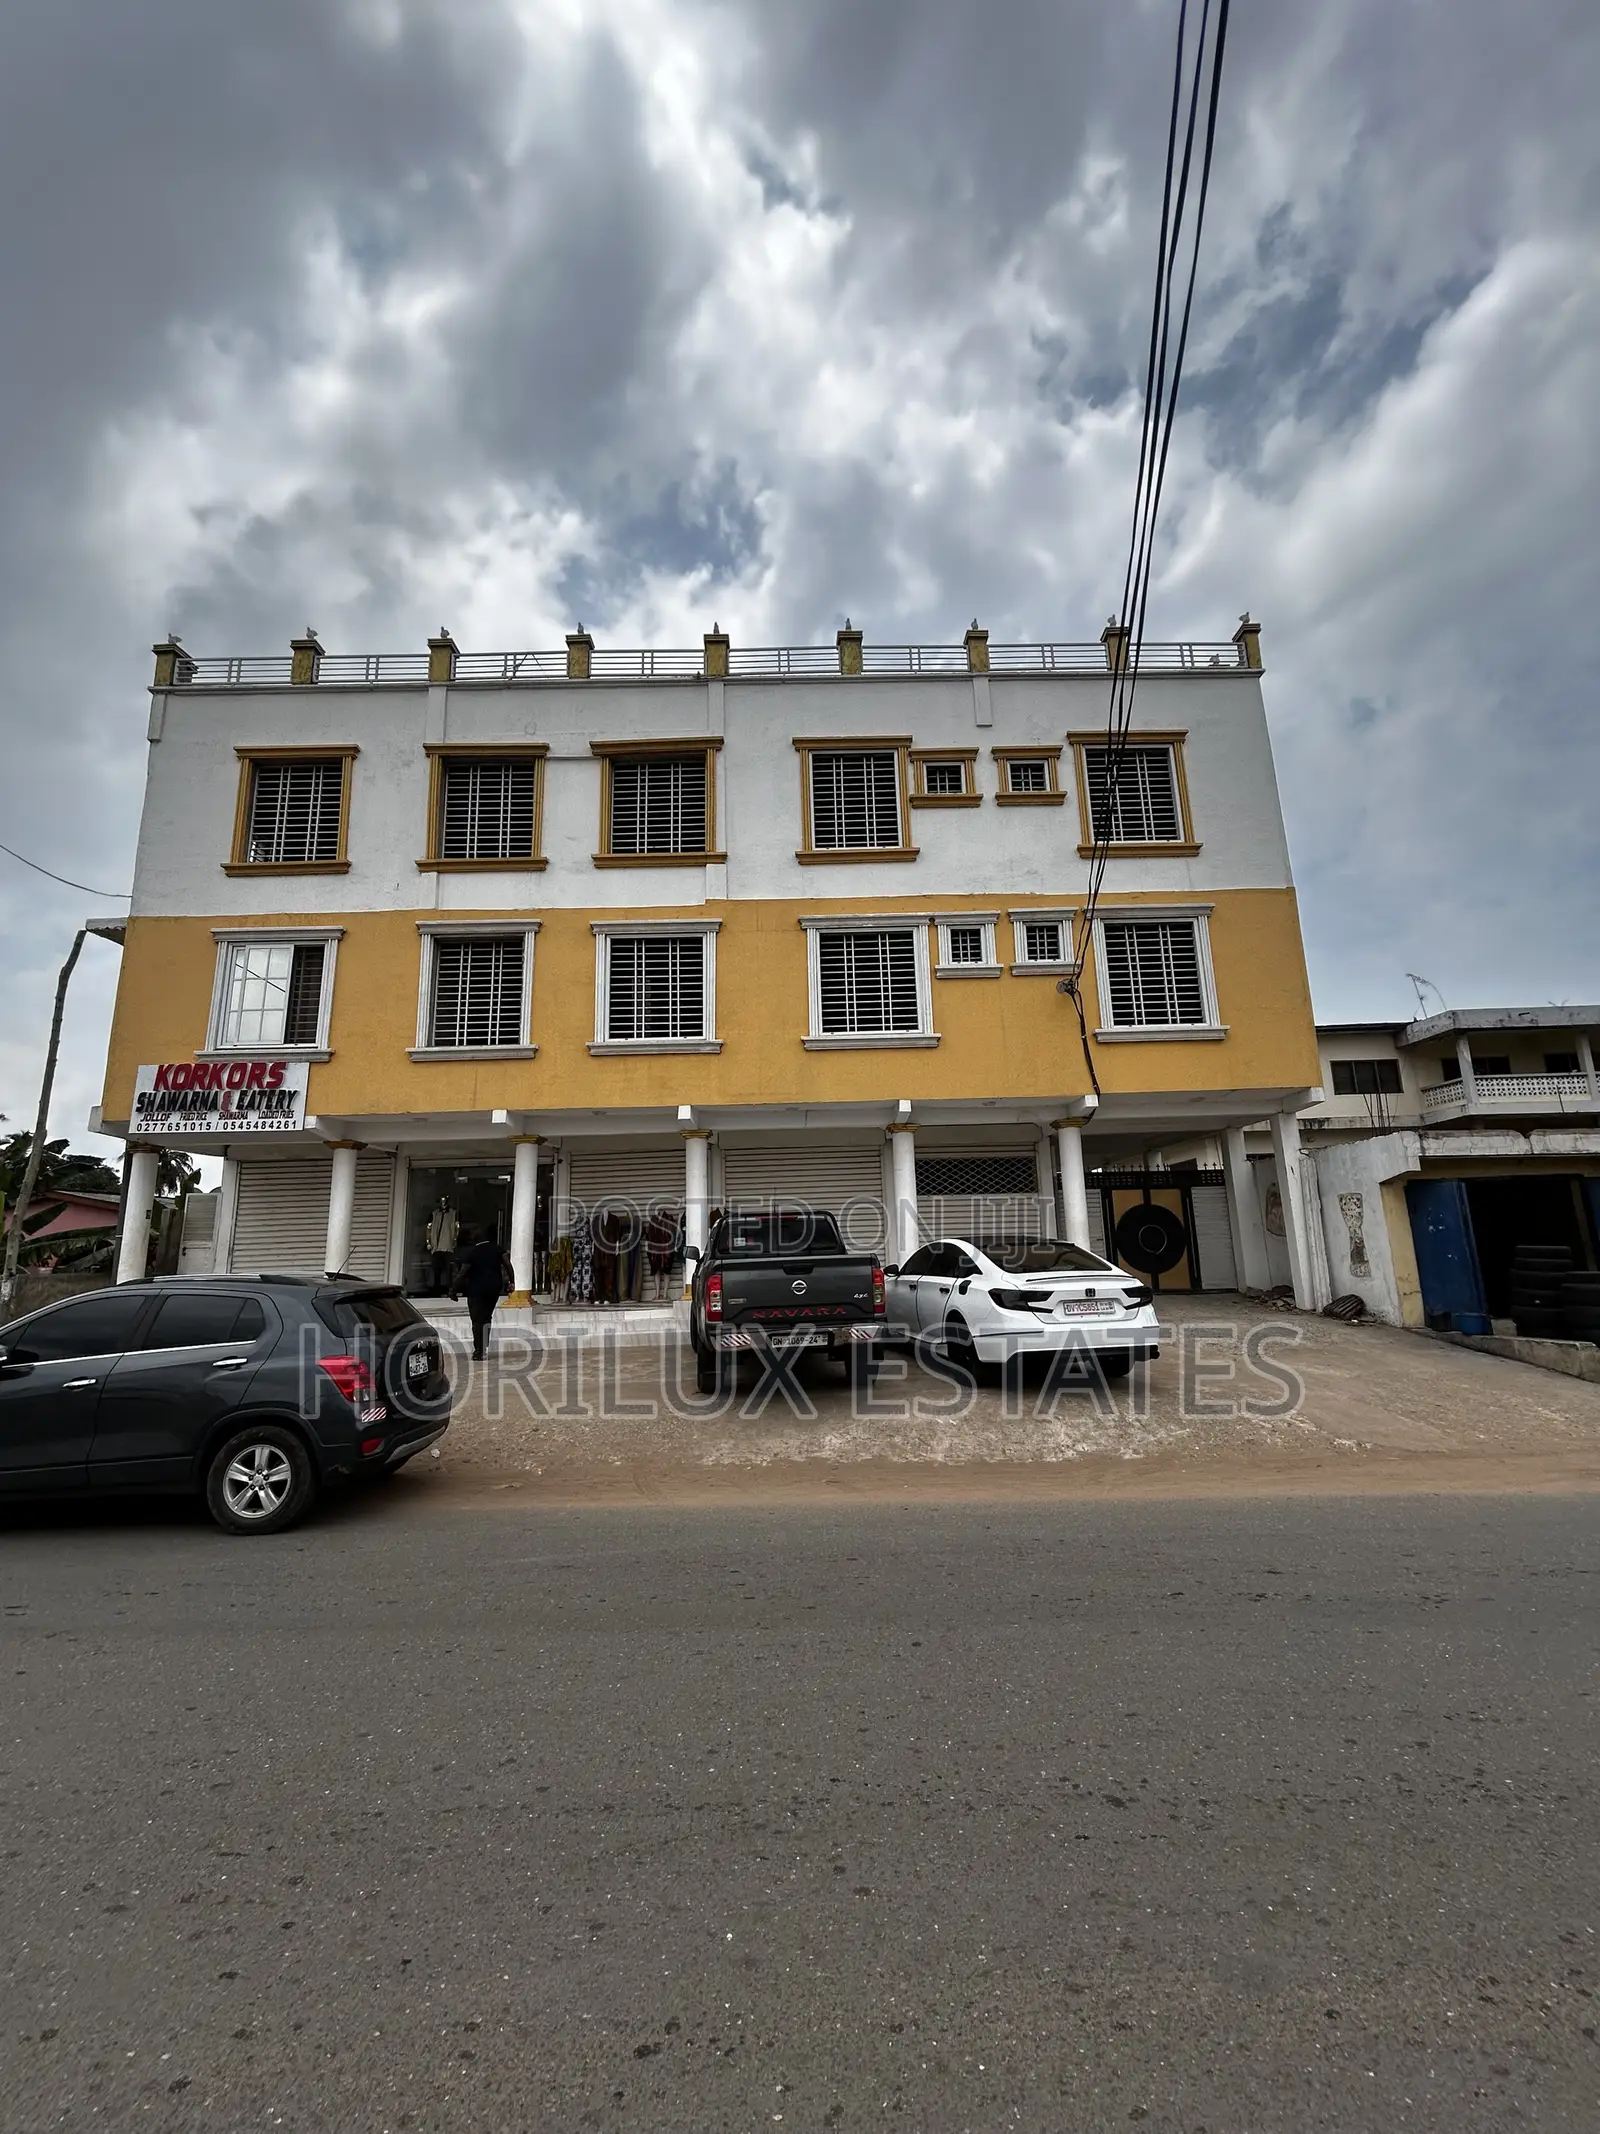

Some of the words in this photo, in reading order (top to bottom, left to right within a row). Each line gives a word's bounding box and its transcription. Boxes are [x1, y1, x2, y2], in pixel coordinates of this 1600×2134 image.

[153, 1061, 289, 1091] KORKORS
[135, 1091, 219, 1113] SHAWARMA
[236, 1089, 300, 1110] EATERY
[140, 1112, 173, 1122] JOLLOF
[752, 1306, 847, 1319] NAVARA
